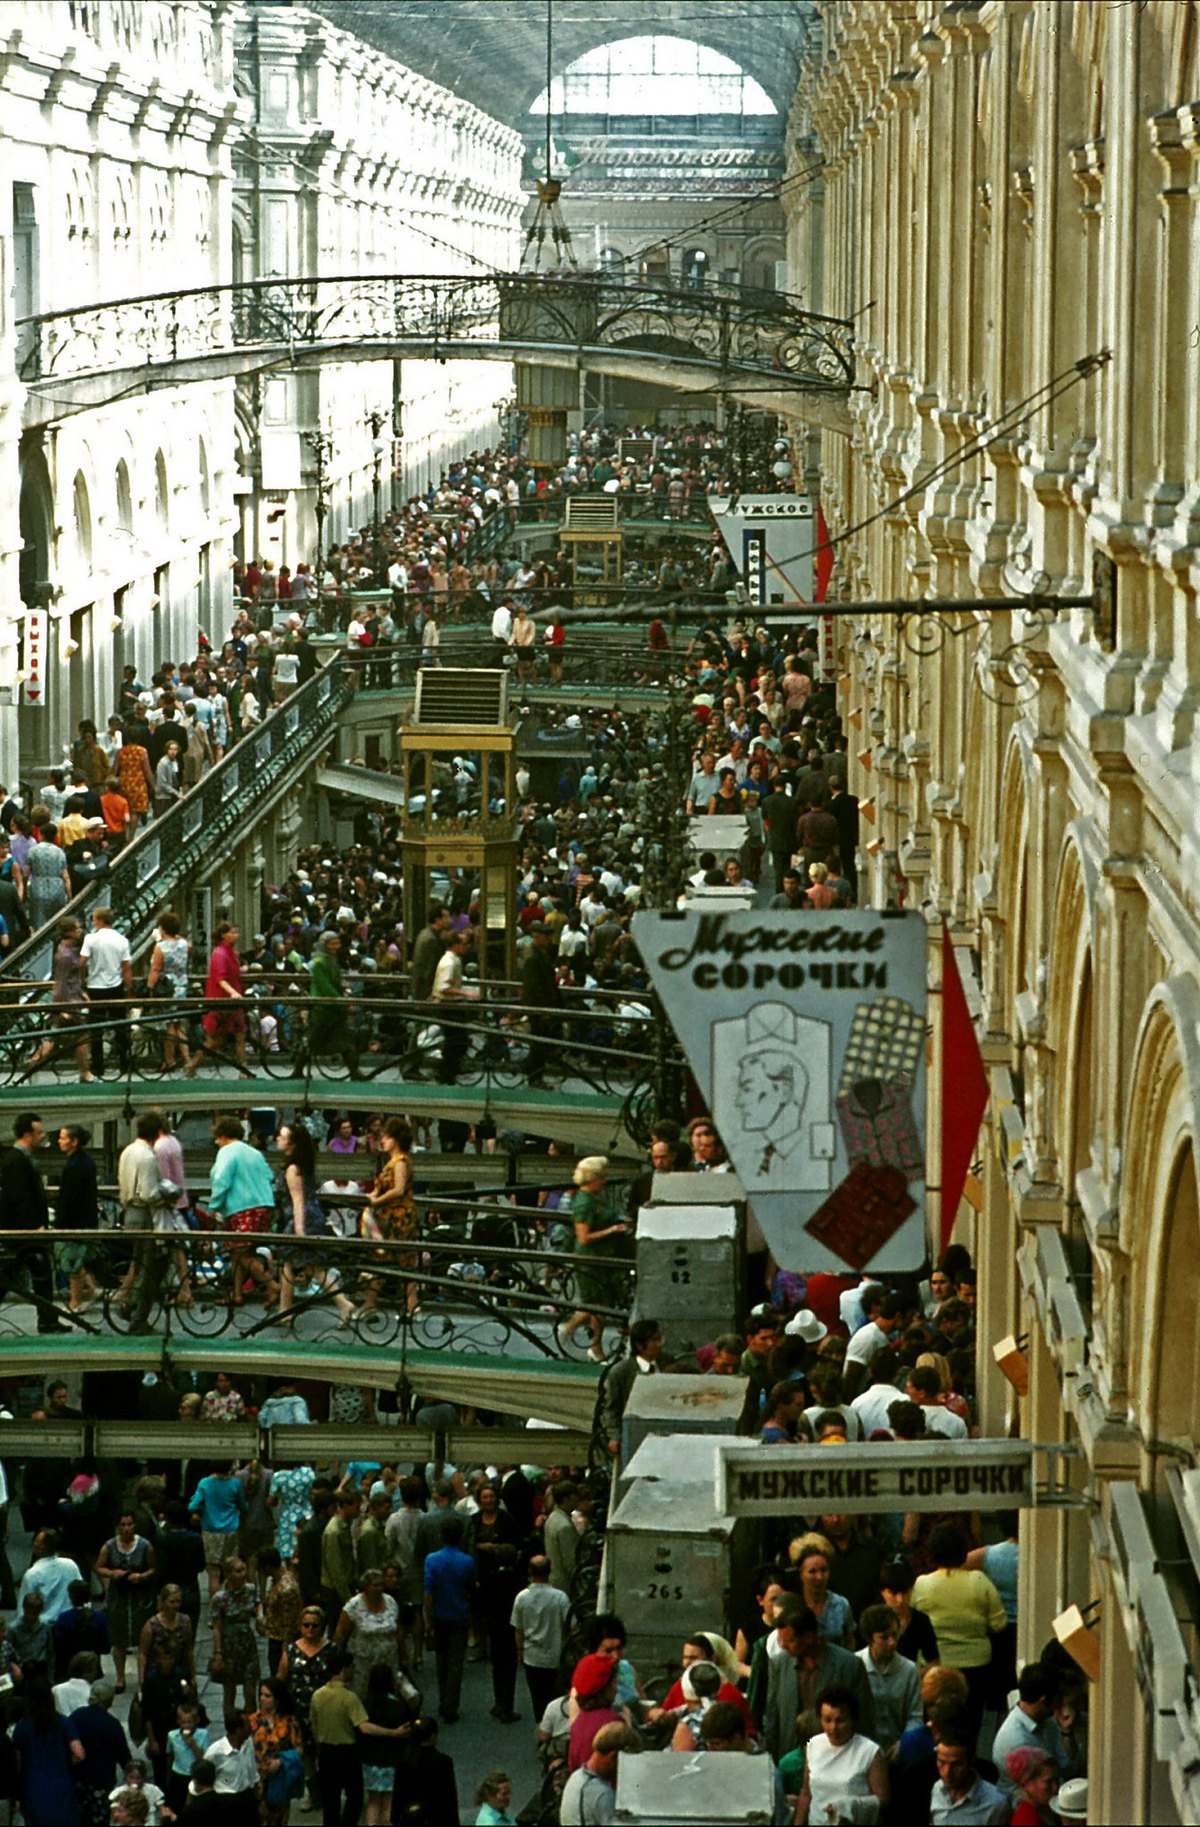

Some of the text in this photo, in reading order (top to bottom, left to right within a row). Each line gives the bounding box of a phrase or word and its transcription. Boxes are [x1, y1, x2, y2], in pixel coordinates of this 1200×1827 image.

[658, 913, 884, 970] Мужские
[692, 962, 887, 989] СОРОЧКИ
[739, 1465, 1024, 1499] МУЖСКИЕ СОРОЧКИ
[648, 1583, 683, 1600] 265
